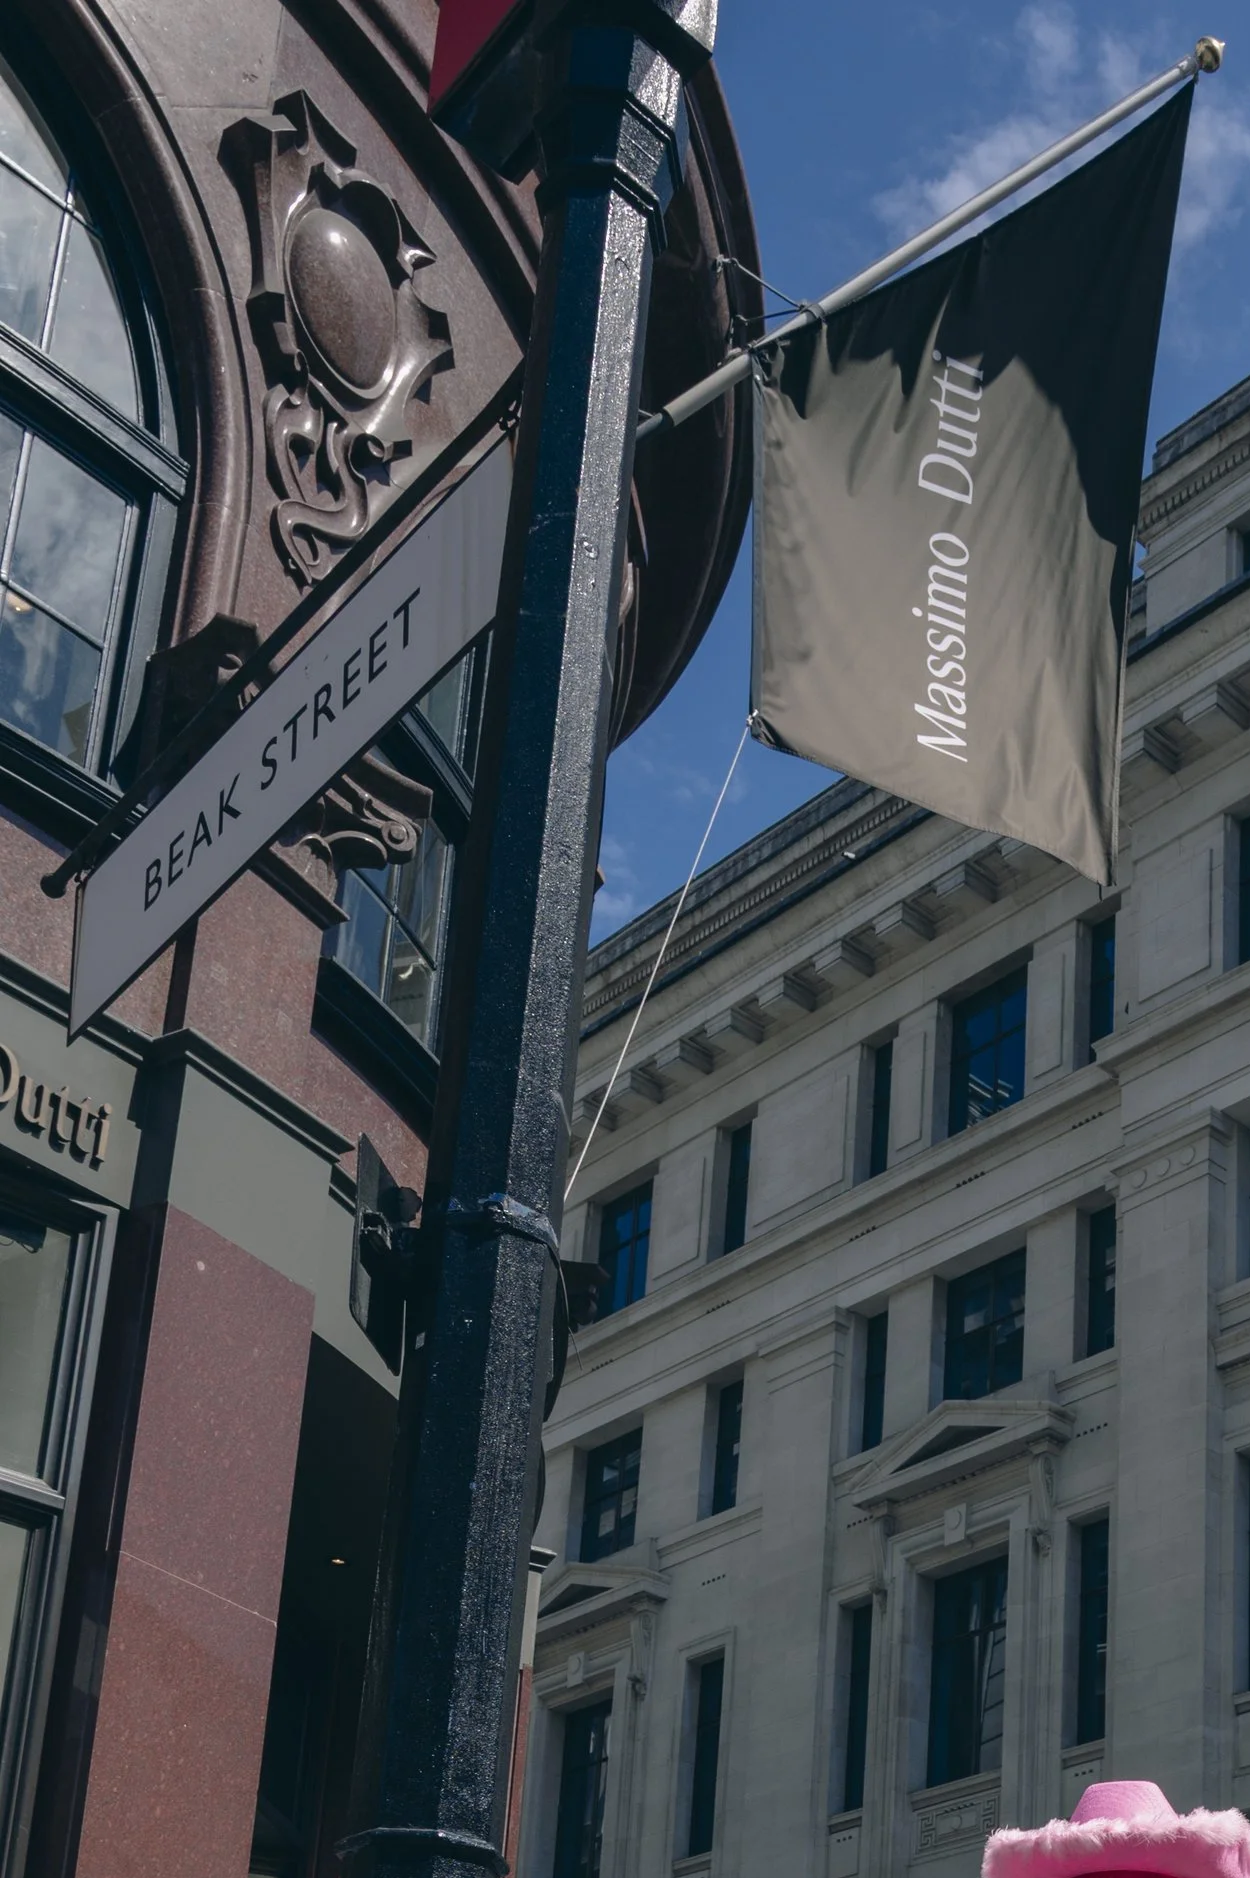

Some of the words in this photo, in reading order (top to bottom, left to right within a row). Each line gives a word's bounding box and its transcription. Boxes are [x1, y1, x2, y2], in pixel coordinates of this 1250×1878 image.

[917, 350, 984, 505] Dutti
[143, 773, 243, 912] BEAK
[260, 587, 421, 791] STREET
[911, 532, 971, 763] Massimo
